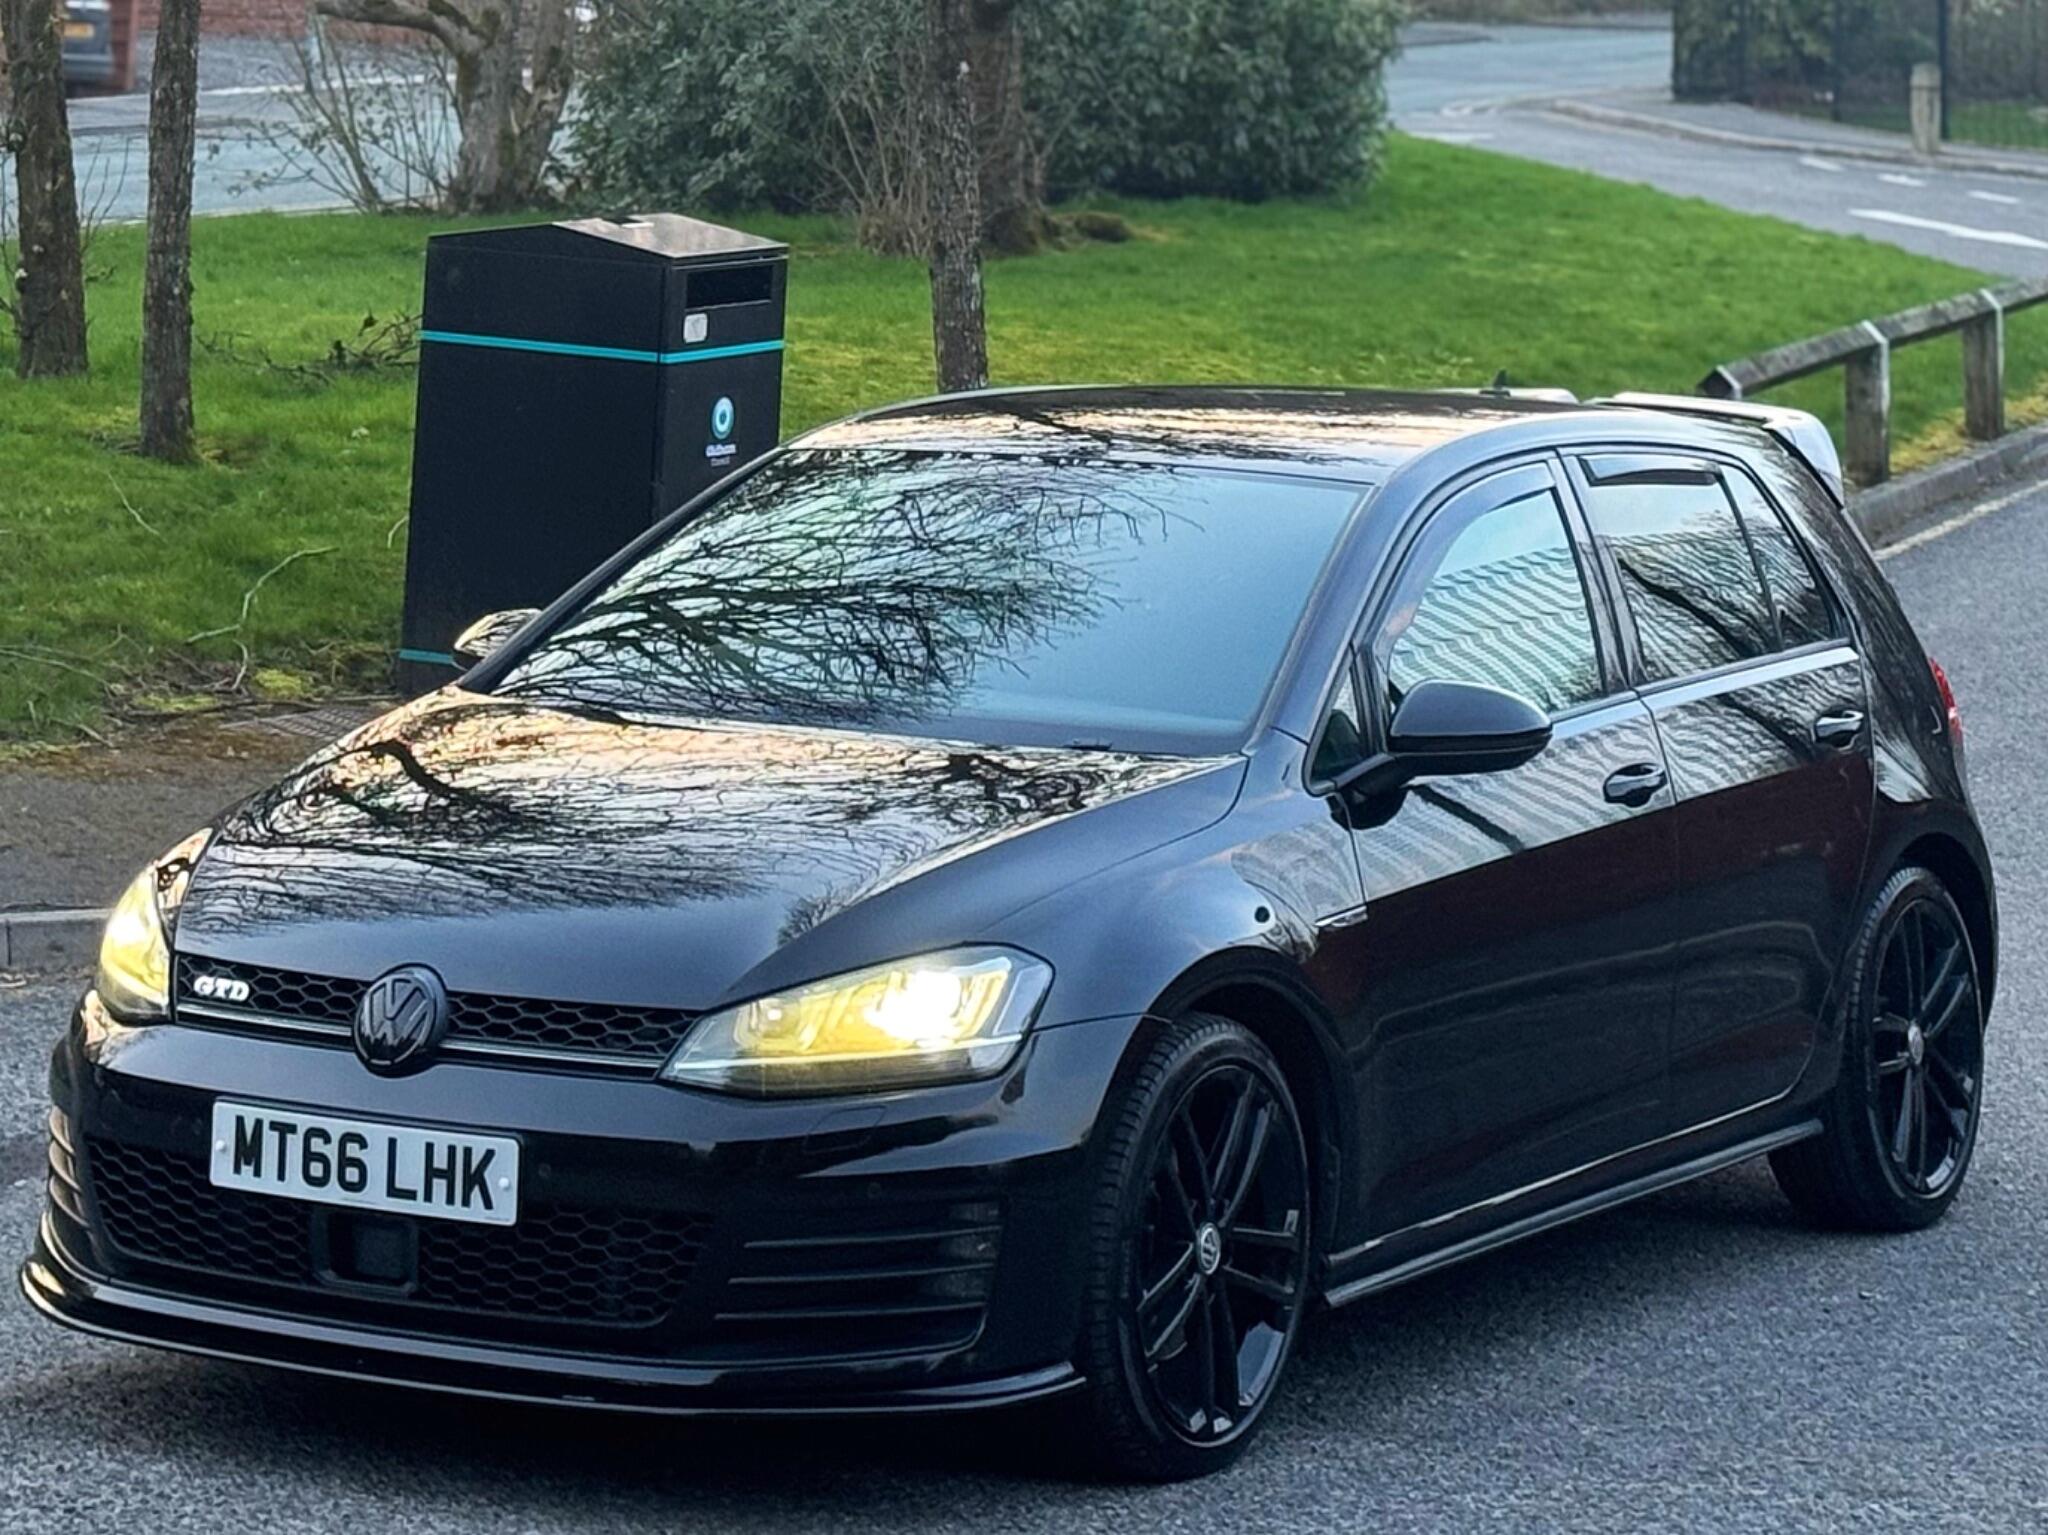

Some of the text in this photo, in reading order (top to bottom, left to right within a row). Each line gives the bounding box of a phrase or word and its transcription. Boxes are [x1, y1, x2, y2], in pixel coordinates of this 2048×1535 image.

[193, 975, 249, 1001] GTD
[232, 1114, 497, 1211] MT66 LHK
